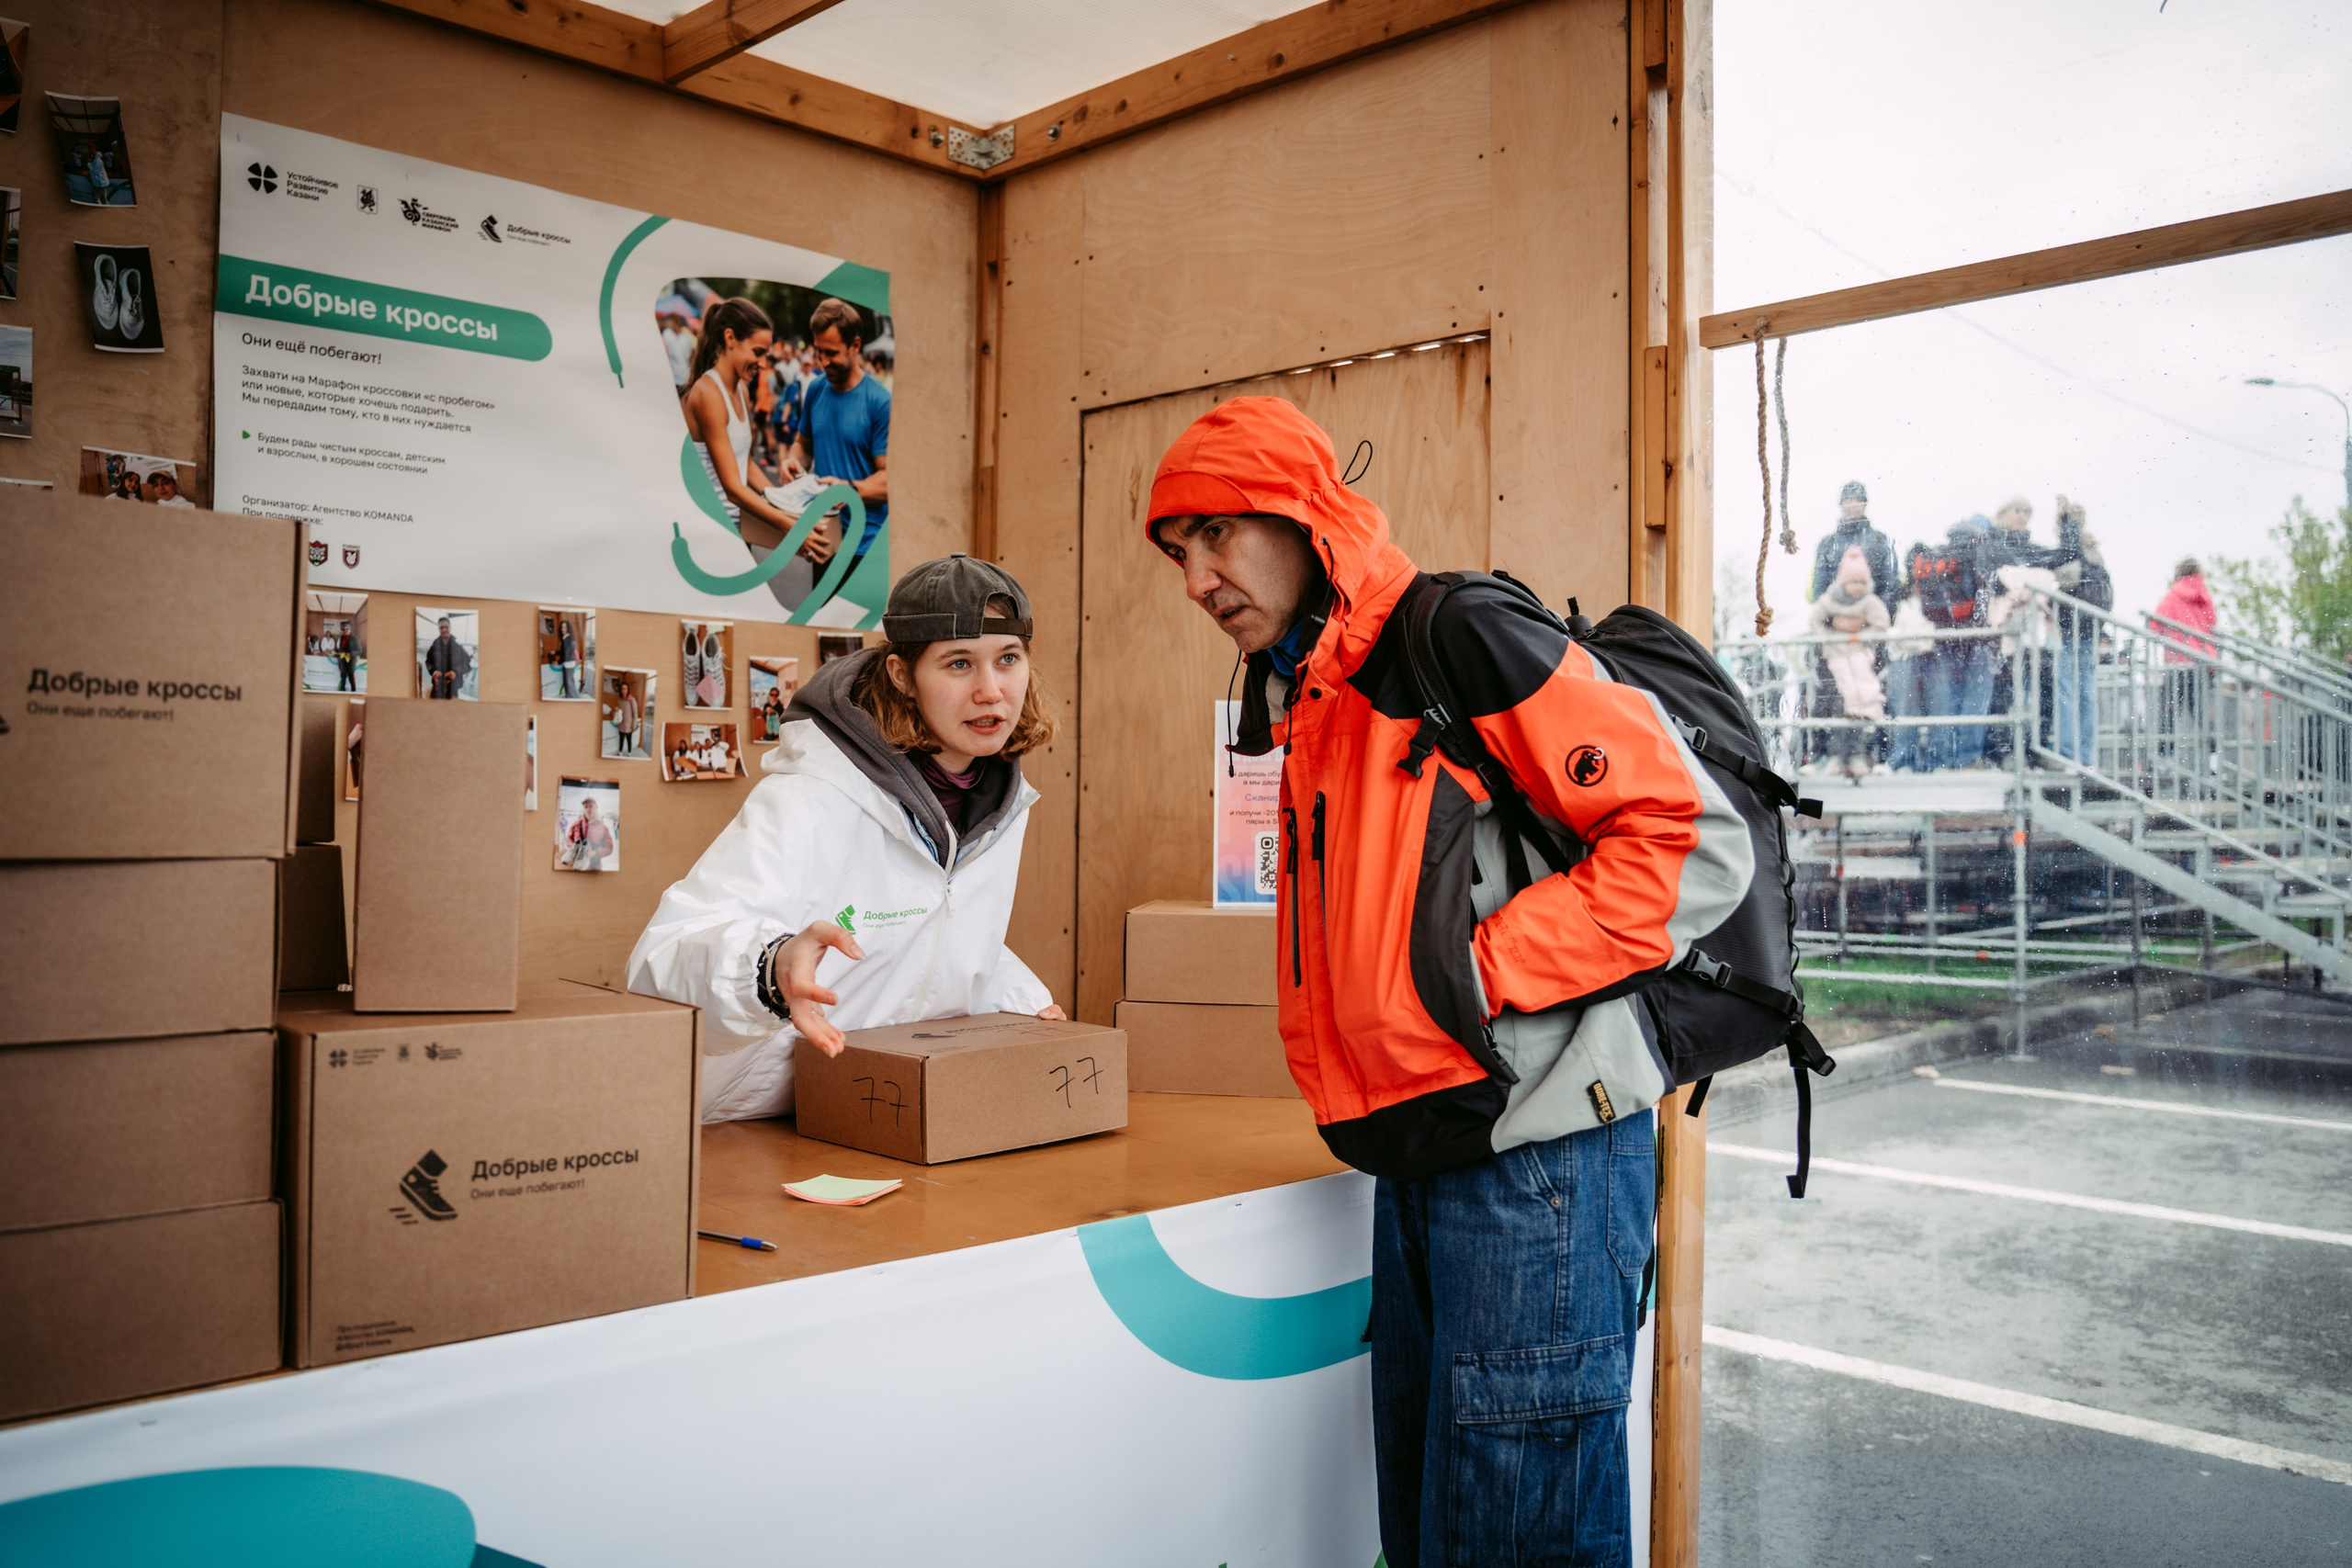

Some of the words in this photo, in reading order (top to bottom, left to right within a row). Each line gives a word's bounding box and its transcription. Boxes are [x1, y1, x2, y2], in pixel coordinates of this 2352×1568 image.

[286, 171, 339, 189] Устойчивое
[286, 180, 329, 196] Развитие
[286, 189, 320, 201] Казани
[507, 223, 539, 237] Добрые
[541, 232, 571, 244] кроссы
[244, 274, 378, 320] Добрые
[385, 303, 498, 341] кроссы
[242, 333, 272, 348] Они
[276, 340, 306, 354] ещё
[310, 344, 382, 365] побегают!
[242, 365, 288, 382] Захвати
[291, 373, 305, 383] на
[309, 376, 360, 392] Марафон
[363, 385, 422, 400] кроссовки
[424, 393, 436, 403] «с
[438, 395, 496, 411] пробегом»
[242, 380, 263, 391] или
[266, 384, 305, 399] новые,
[308, 390, 356, 405] которые
[358, 398, 399, 411] хочешь
[401, 403, 454, 419] подарить.
[242, 392, 260, 404] Мы
[264, 396, 327, 414] передадим
[330, 406, 359, 420] тому,
[362, 411, 381, 422] кто
[383, 413, 390, 423] в
[392, 415, 412, 426] них
[413, 418, 471, 434] нуждается
[257, 446, 265, 455] и
[266, 446, 320, 462] взрослым,
[329, 456, 375, 469] хорошем
[376, 461, 429, 474] состоянии
[258, 432, 290, 446] Будем
[291, 437, 318, 450] рады
[319, 442, 357, 455] чистым
[359, 447, 403, 460] кроссам,
[405, 452, 447, 465] детским
[242, 494, 310, 512] Организатор:
[311, 504, 362, 518] Агентство
[364, 510, 413, 524] KOMANDA
[242, 507, 263, 518] При
[266, 512, 323, 525] поддержке:
[27, 668, 140, 700] Добрые
[147, 680, 243, 703] кроссы
[26, 700, 59, 716] Они
[97, 705, 175, 722] побегают!
[1245, 793, 1279, 804] Сканир
[863, 910, 899, 922] Добрые
[899, 907, 928, 919] кроссы
[1049, 1056, 1104, 1110] 77
[853, 1077, 910, 1128] 77
[1592, 1082, 1614, 1119] GORE-TEX
[471, 1153, 558, 1182] Добрые
[562, 1148, 639, 1177] кроссы
[469, 1188, 496, 1201] Они
[526, 1178, 585, 1194] побегают!
